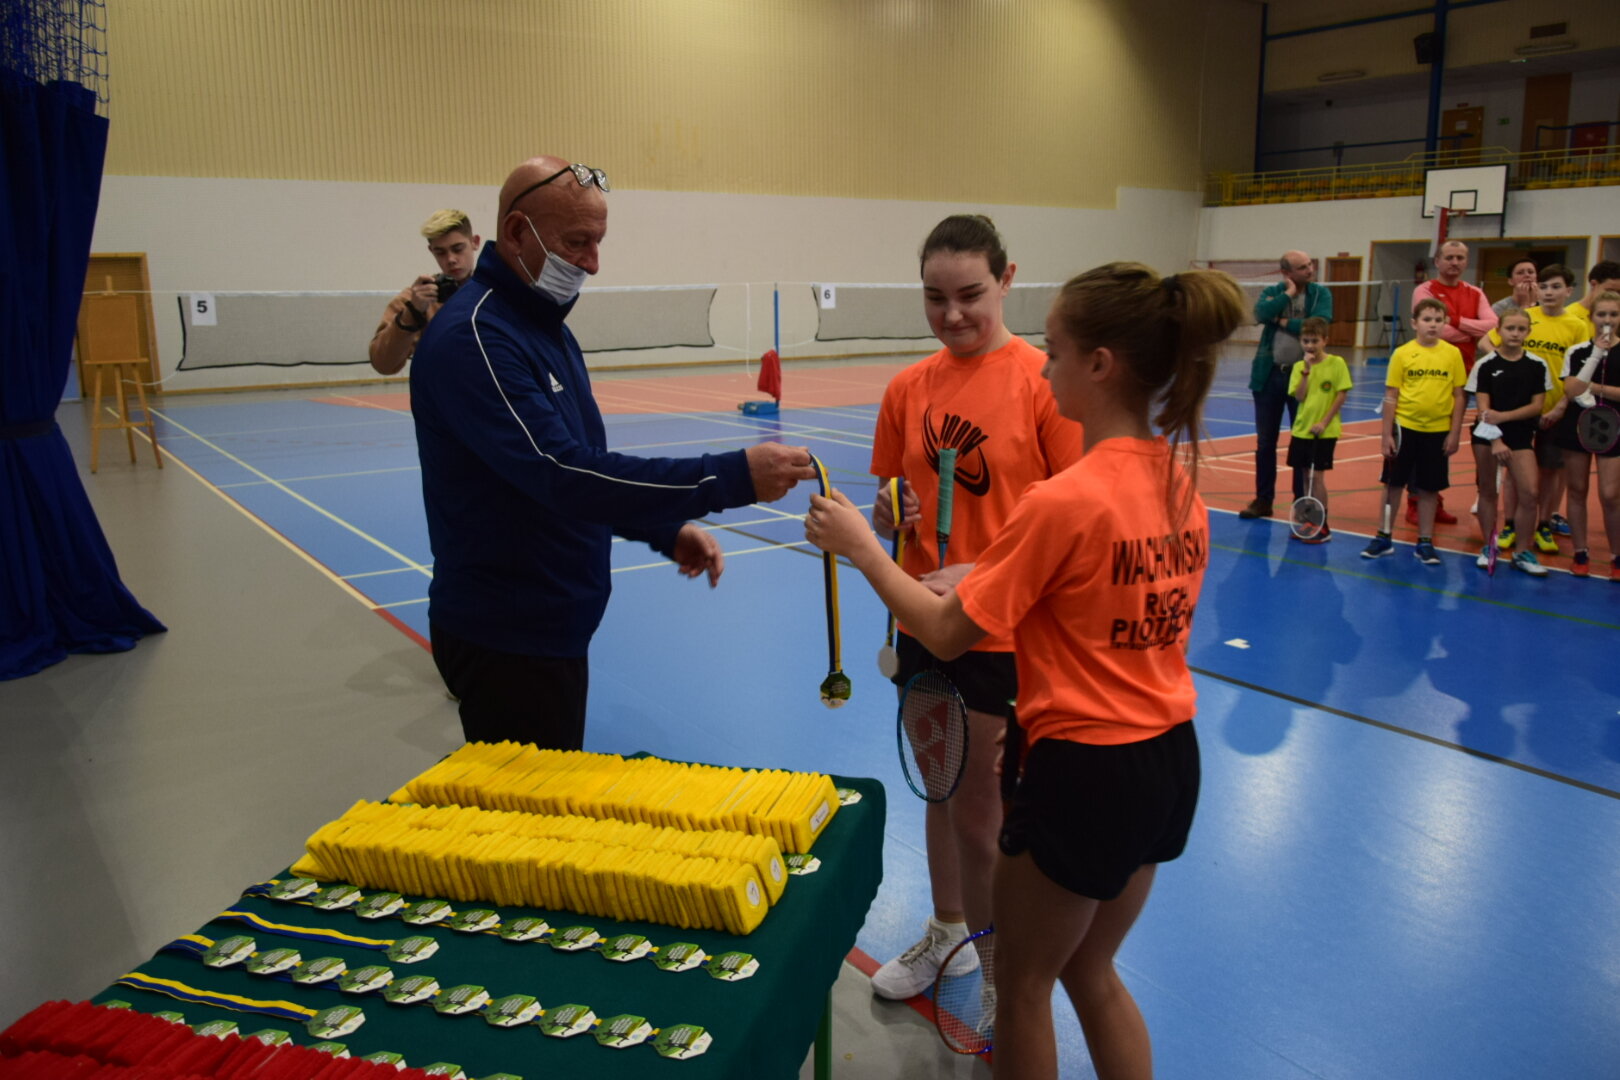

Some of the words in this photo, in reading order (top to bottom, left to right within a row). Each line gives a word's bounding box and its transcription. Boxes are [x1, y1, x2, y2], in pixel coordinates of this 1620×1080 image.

[823, 289, 831, 300] 6
[197, 300, 208, 313] 5
[1408, 368, 1448, 378] BIOFARM
